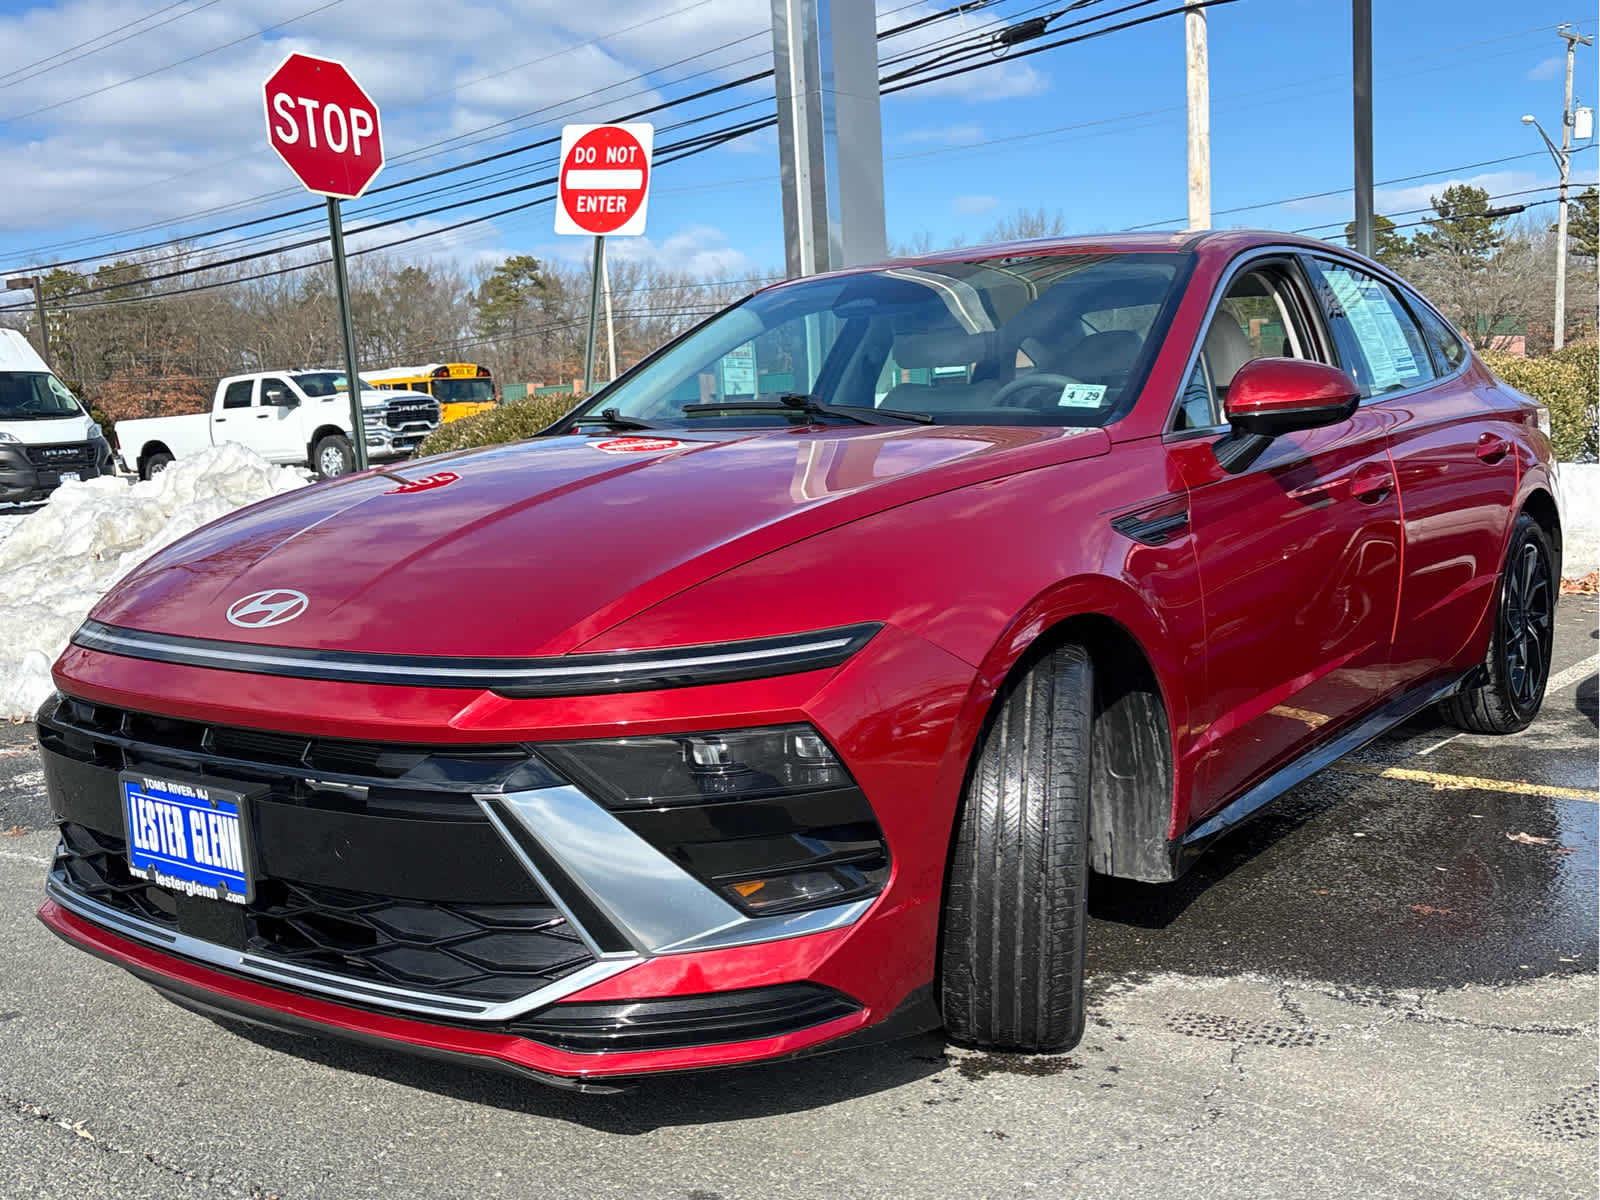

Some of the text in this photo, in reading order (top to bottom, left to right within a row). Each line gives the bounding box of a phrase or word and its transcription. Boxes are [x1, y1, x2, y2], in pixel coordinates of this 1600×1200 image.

[273, 92, 374, 156] STOP
[575, 145, 638, 164] DO NOT
[576, 195, 628, 213] ENTER
[1067, 391, 1100, 401] 4 29
[143, 778, 167, 792] TOMS
[196, 788, 209, 801] NJ
[130, 796, 244, 873] LESTER GLENN
[154, 870, 218, 900] lesterglenn
